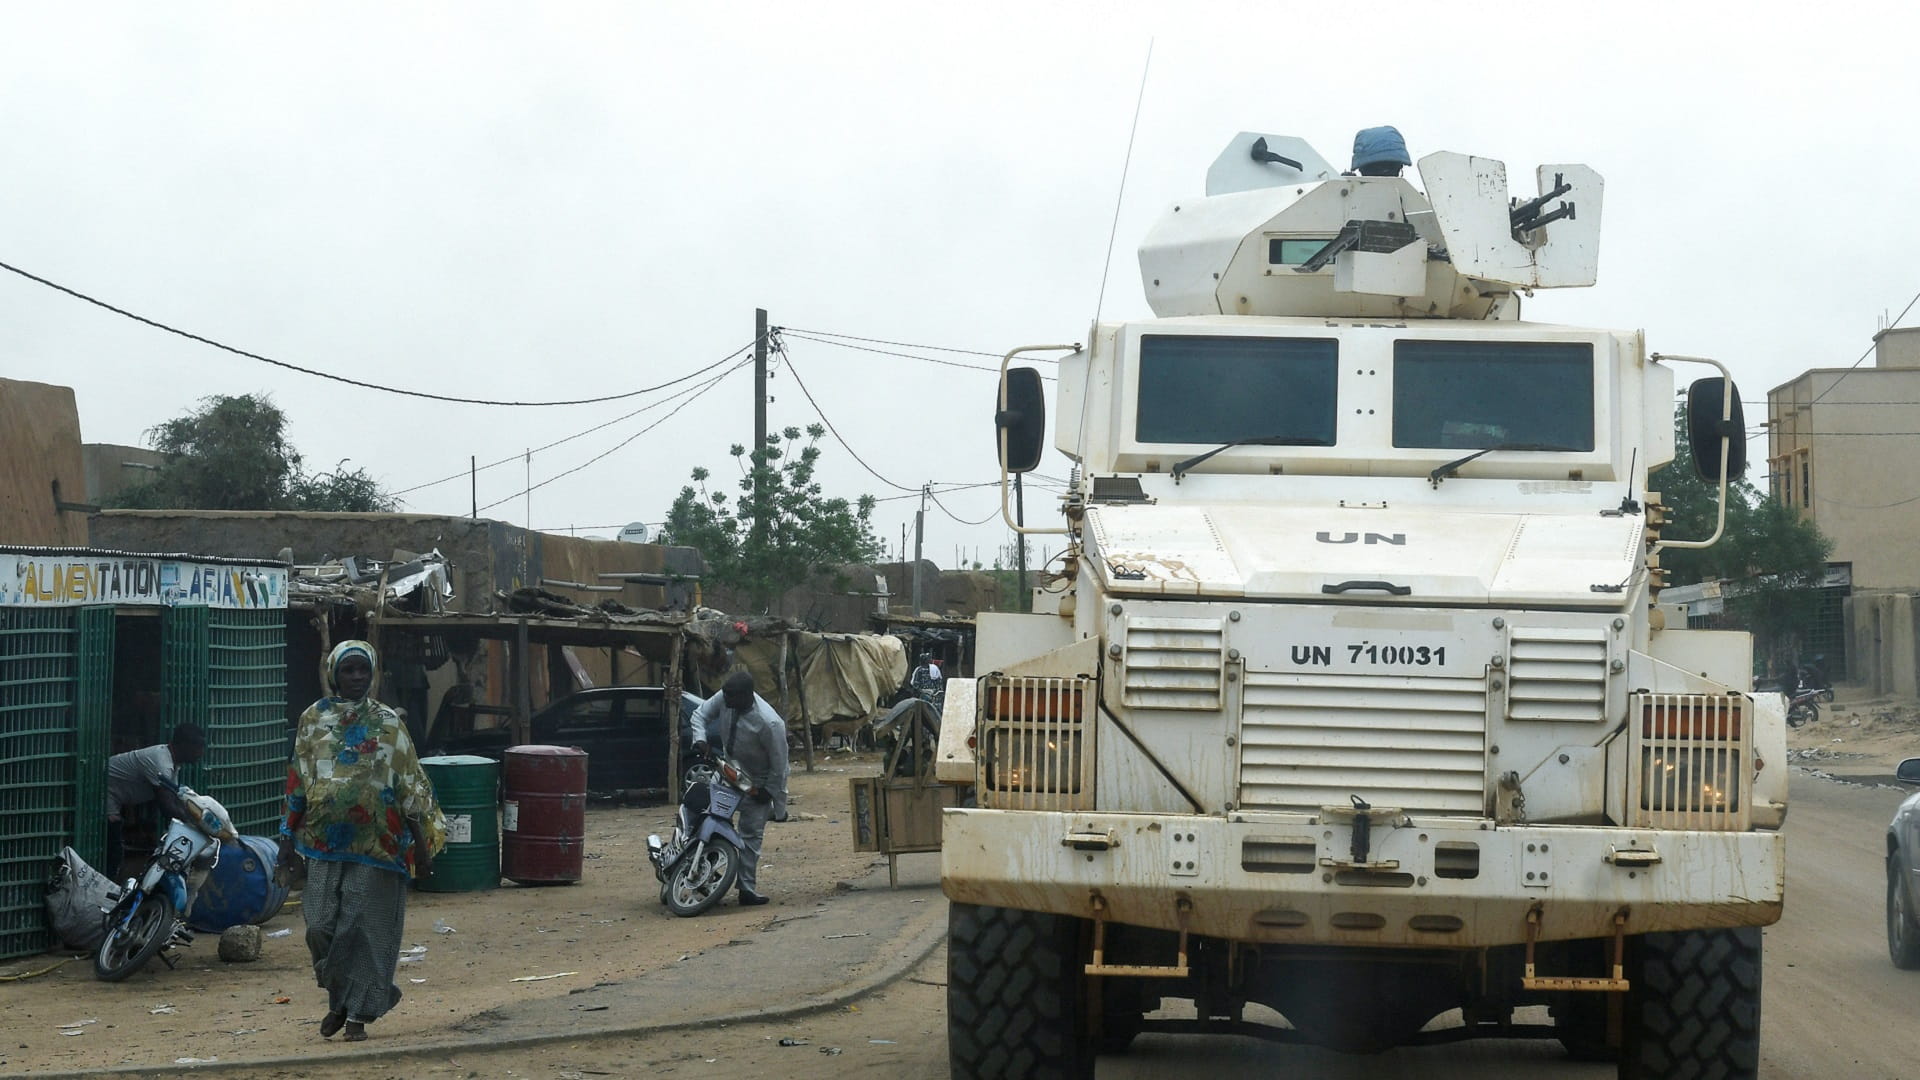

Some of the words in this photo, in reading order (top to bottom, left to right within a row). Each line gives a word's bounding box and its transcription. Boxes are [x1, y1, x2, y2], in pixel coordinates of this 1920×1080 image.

[1315, 531, 1407, 546] UN
[24, 560, 162, 604] ALIMENTATION
[1291, 645, 1332, 667] UN
[1347, 644, 1446, 667] 710031
